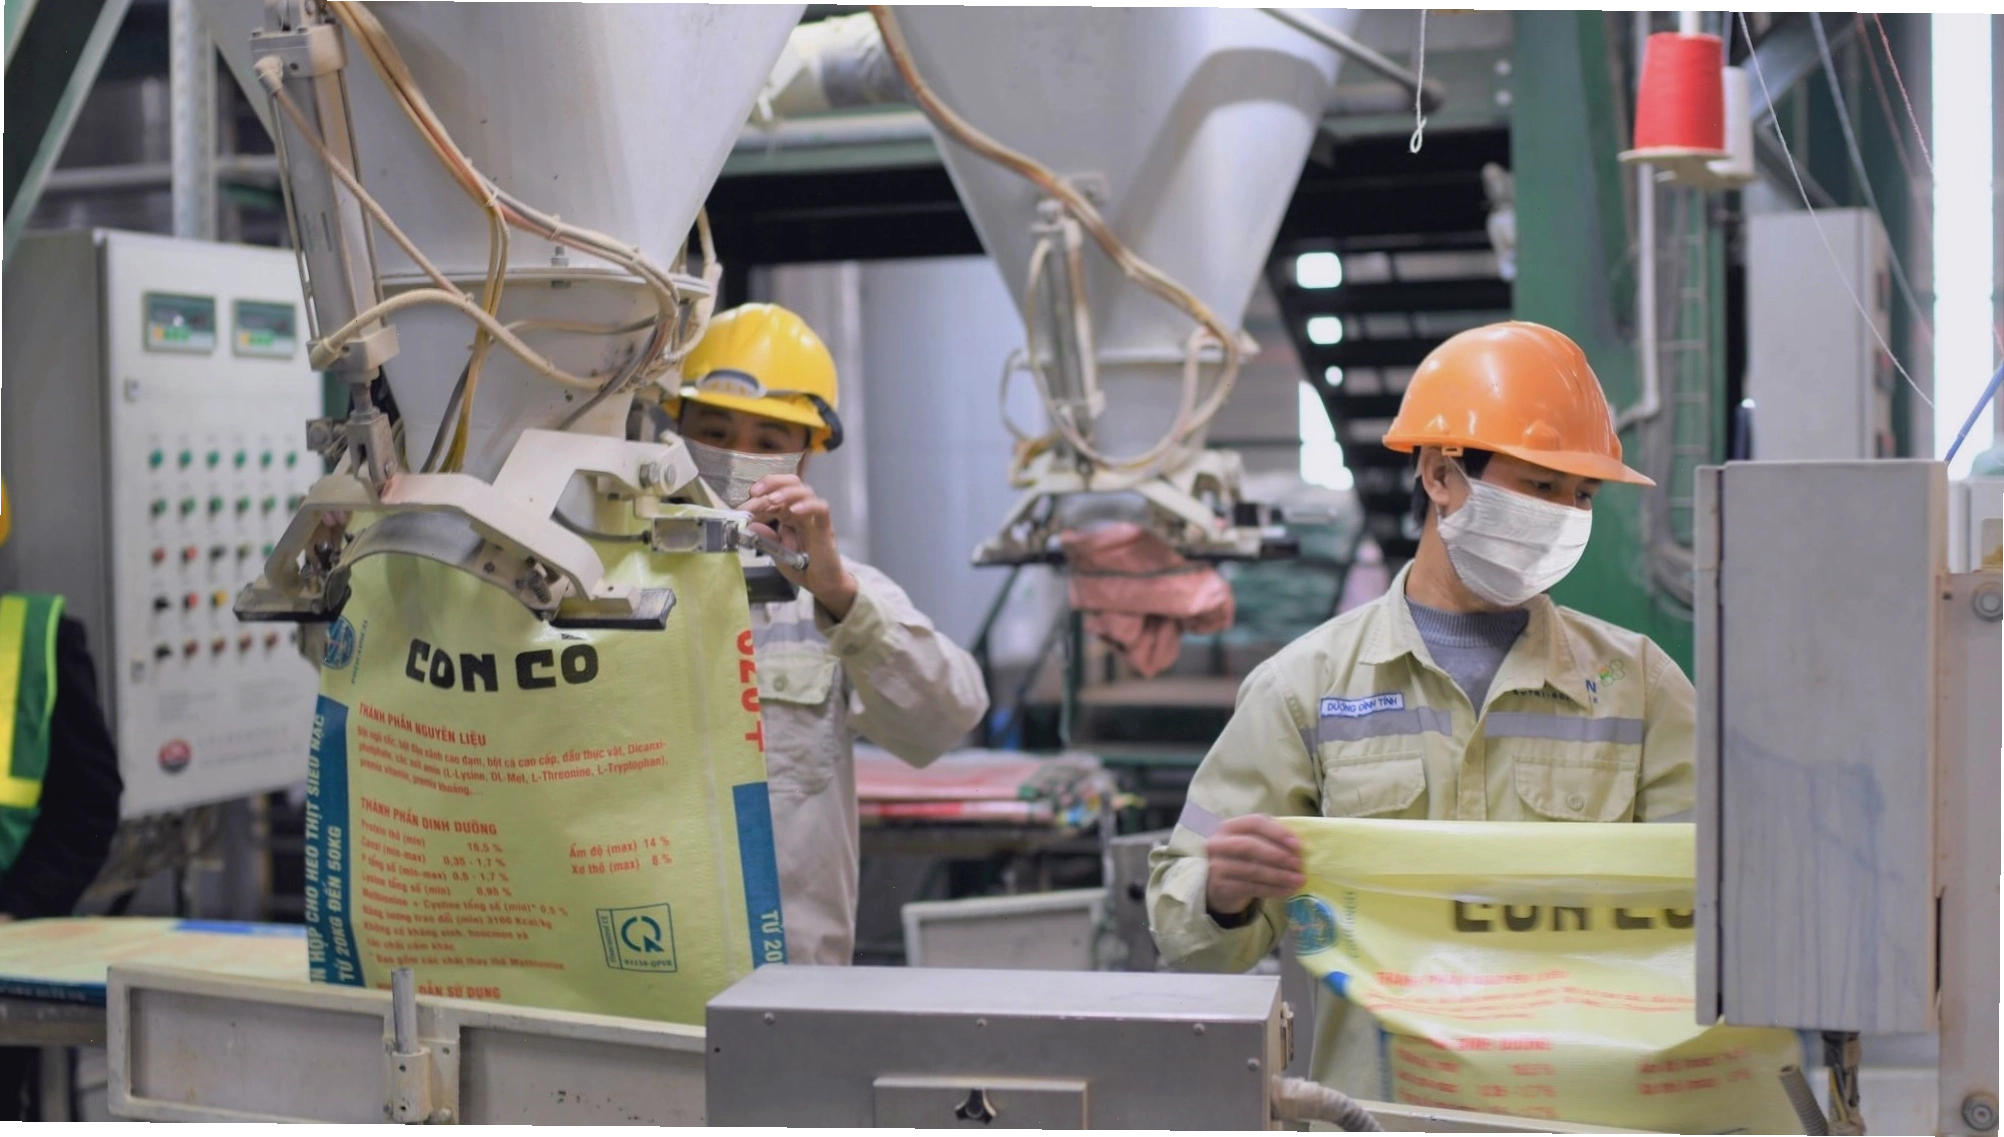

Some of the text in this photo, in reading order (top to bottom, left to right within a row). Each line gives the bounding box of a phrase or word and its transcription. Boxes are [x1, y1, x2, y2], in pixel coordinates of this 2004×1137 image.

[405, 638, 499, 692] CON
[310, 714, 325, 751] NẠC
[359, 702, 487, 748] THÀNH PHẦN NGUYÊN LIỆU
[518, 757, 537, 768] cao
[583, 747, 605, 762] thực
[305, 800, 323, 840] THỊT
[360, 797, 498, 836] THÀNH PHẦN DINH DƯỠNG
[304, 845, 320, 882] HEO
[327, 825, 343, 872] 50KG
[607, 840, 638, 857] (max)
[644, 837, 657, 849] 14
[588, 862, 605, 875] thô
[609, 858, 640, 875] (max)
[305, 886, 320, 923] CHO
[321, 874, 342, 913] ĐẾN
[308, 926, 329, 962] HỢP
[329, 915, 351, 957] 20KG
[763, 939, 784, 964] 20
